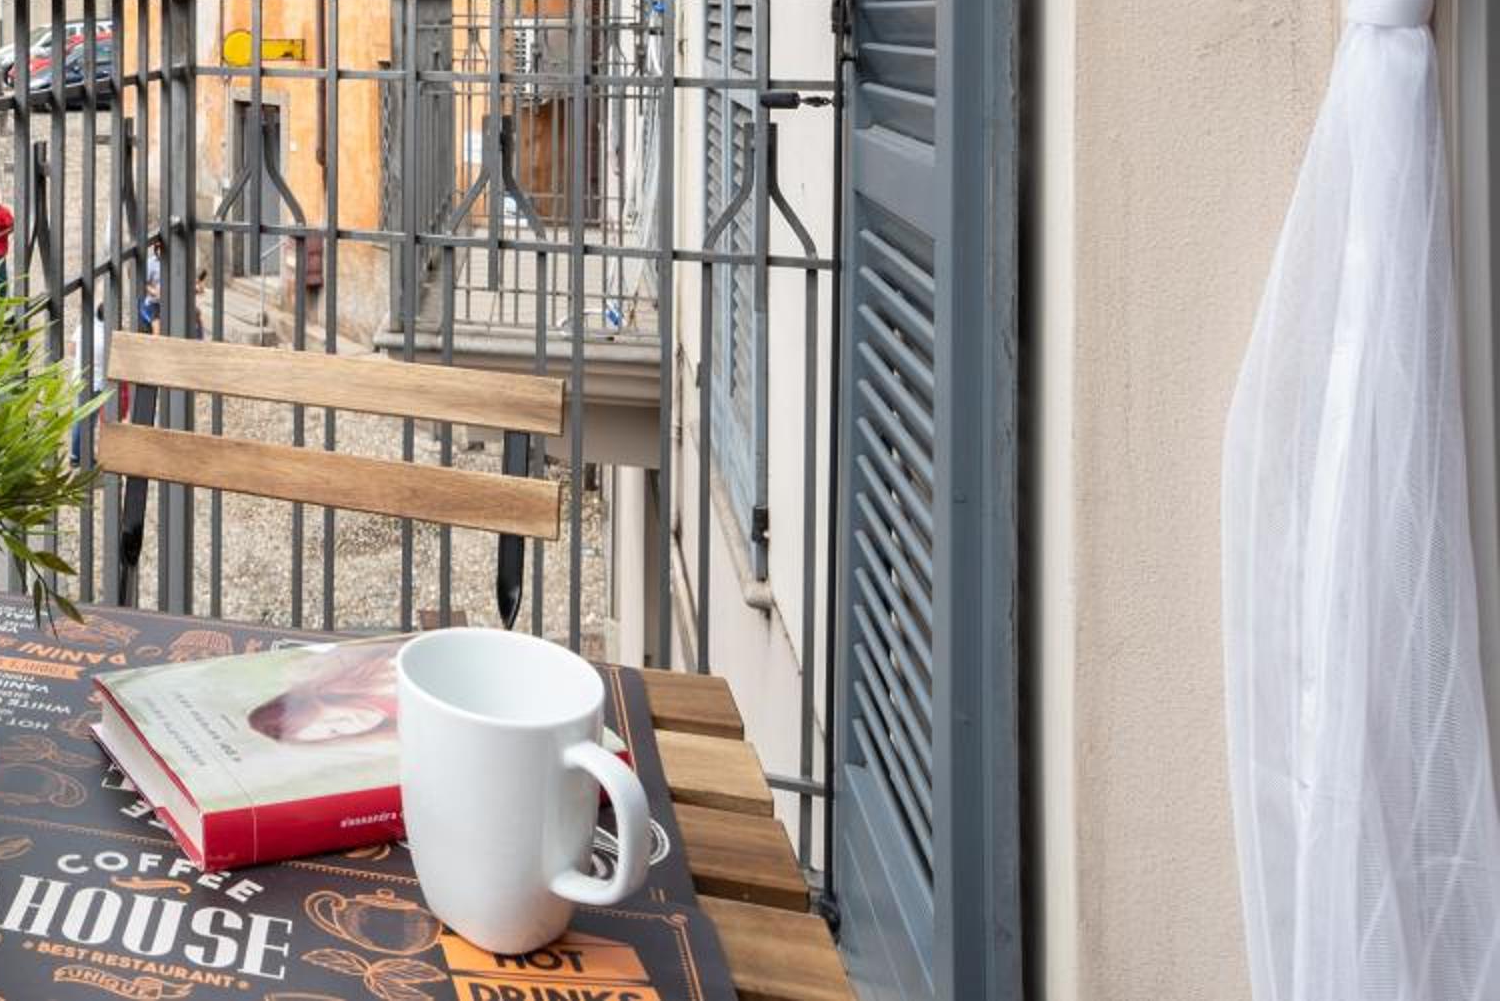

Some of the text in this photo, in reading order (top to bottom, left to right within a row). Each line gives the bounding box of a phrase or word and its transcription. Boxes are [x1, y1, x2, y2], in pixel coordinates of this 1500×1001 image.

[7, 698, 71, 715] WHITE
[5, 717, 50, 730] HOT
[57, 851, 265, 903] COFFEE
[37, 941, 236, 988] BEST RESTAURANT
